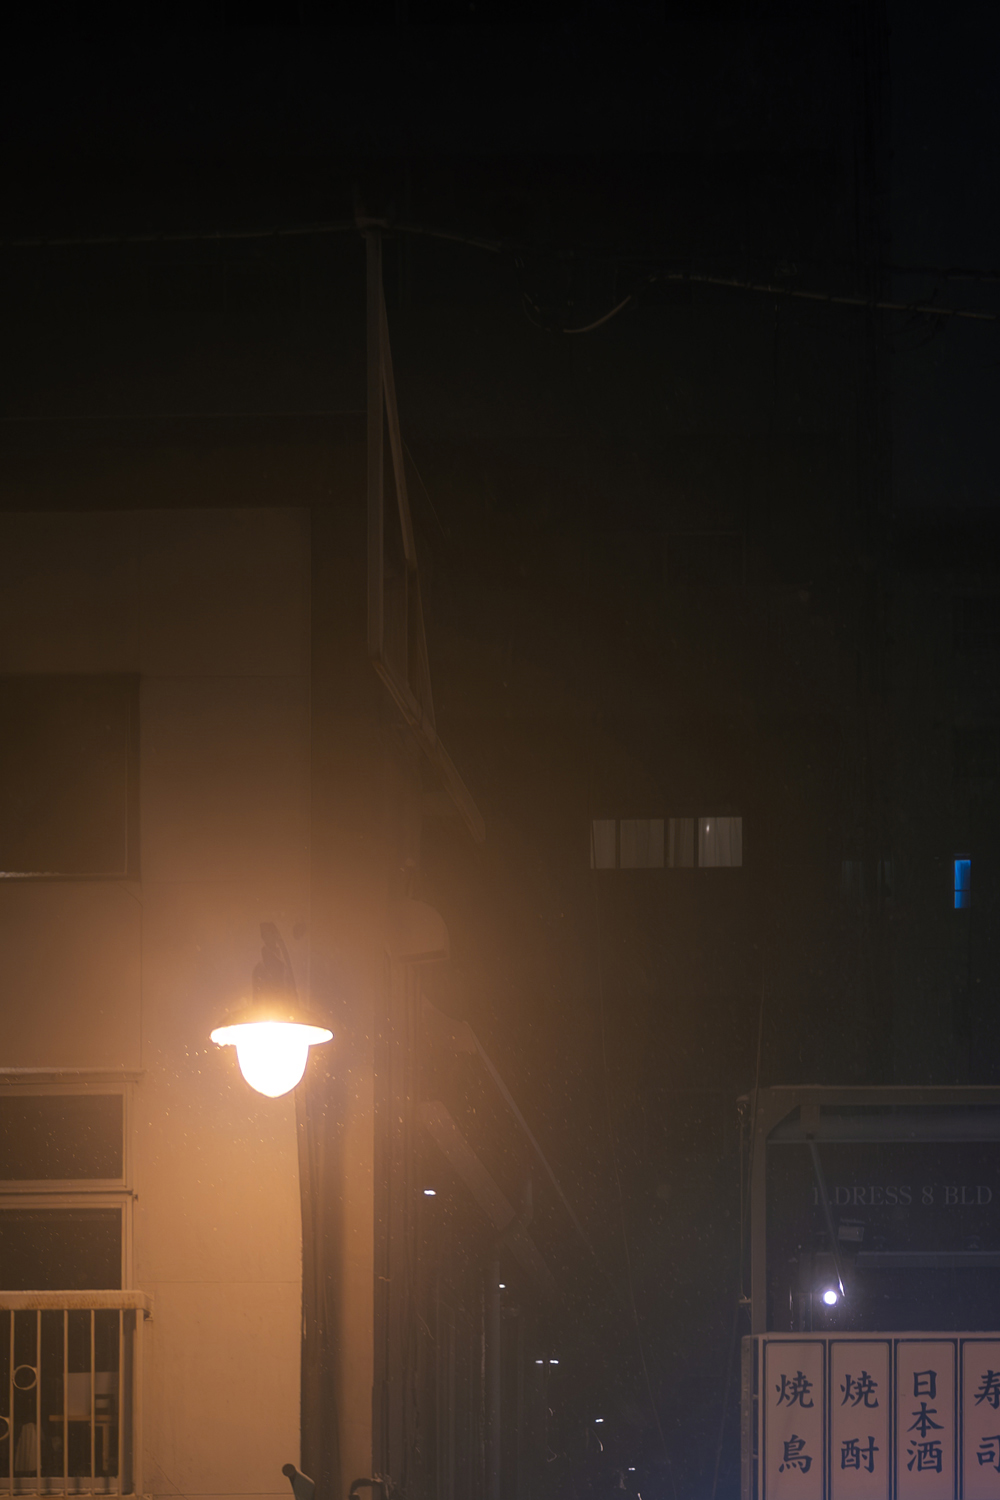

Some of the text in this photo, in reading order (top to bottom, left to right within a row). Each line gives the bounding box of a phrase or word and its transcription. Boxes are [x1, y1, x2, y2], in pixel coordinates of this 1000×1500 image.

[921, 1185, 934, 1206] 8
[942, 1185, 993, 1206] BLD
[776, 1371, 814, 1473] 焼鳥
[840, 1371, 879, 1473] 焼酎
[907, 1370, 944, 1473] 日本酒
